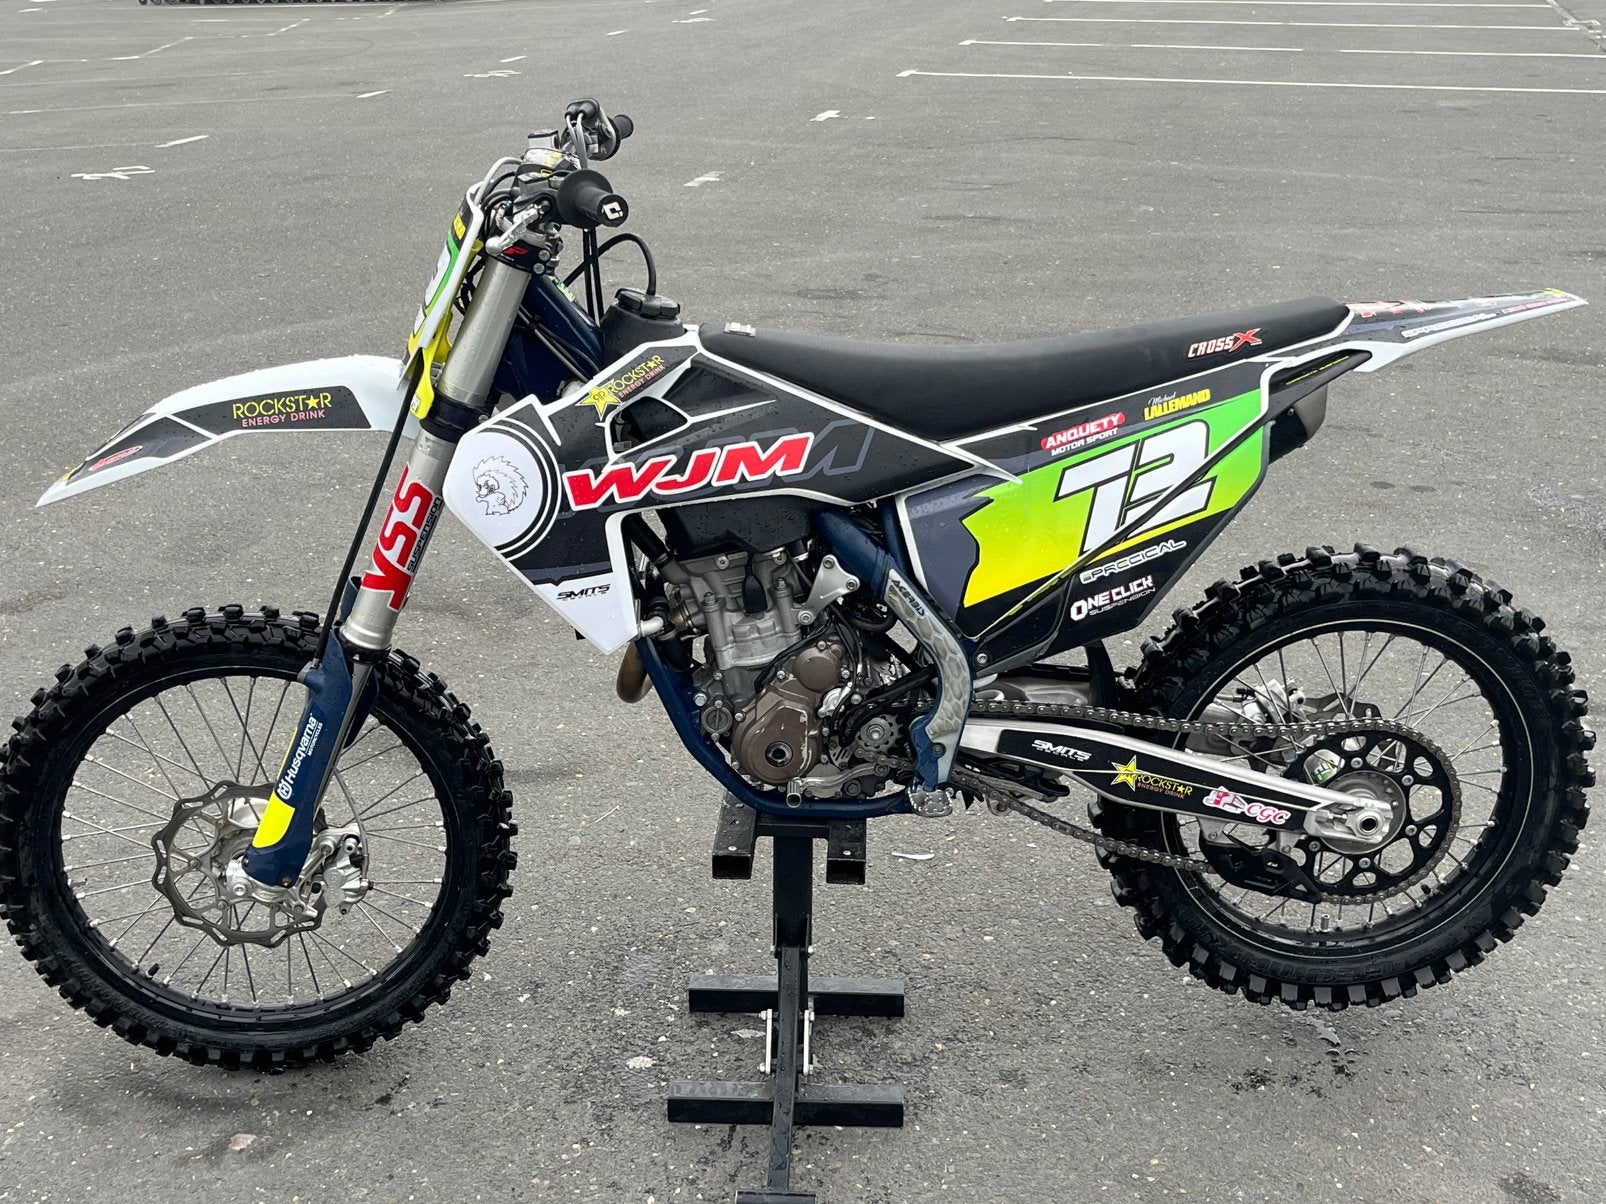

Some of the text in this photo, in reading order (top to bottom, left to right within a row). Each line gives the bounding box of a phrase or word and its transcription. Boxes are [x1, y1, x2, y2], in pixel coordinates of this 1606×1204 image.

[618, 364, 667, 398] ENERGY DRINK
[241, 409, 326, 428] ENERGY DRINK
[1143, 388, 1212, 421] LALLEMAND
[1044, 412, 1123, 449] ANQUETY
[1051, 428, 1119, 457] MOTOR SPORT
[563, 433, 814, 510] WJM
[361, 462, 434, 612] YSS
[406, 497, 443, 575] SUSPENSION
[556, 583, 611, 600] SMITS
[1070, 575, 1154, 621] ONE CLICK
[1089, 587, 1156, 616] SUSPENSION
[284, 716, 317, 785] Husqvarna
[1031, 739, 1092, 761] SMITS
[1136, 782, 1186, 799] ENERGY DRINK
[1245, 802, 1292, 825] CGC
